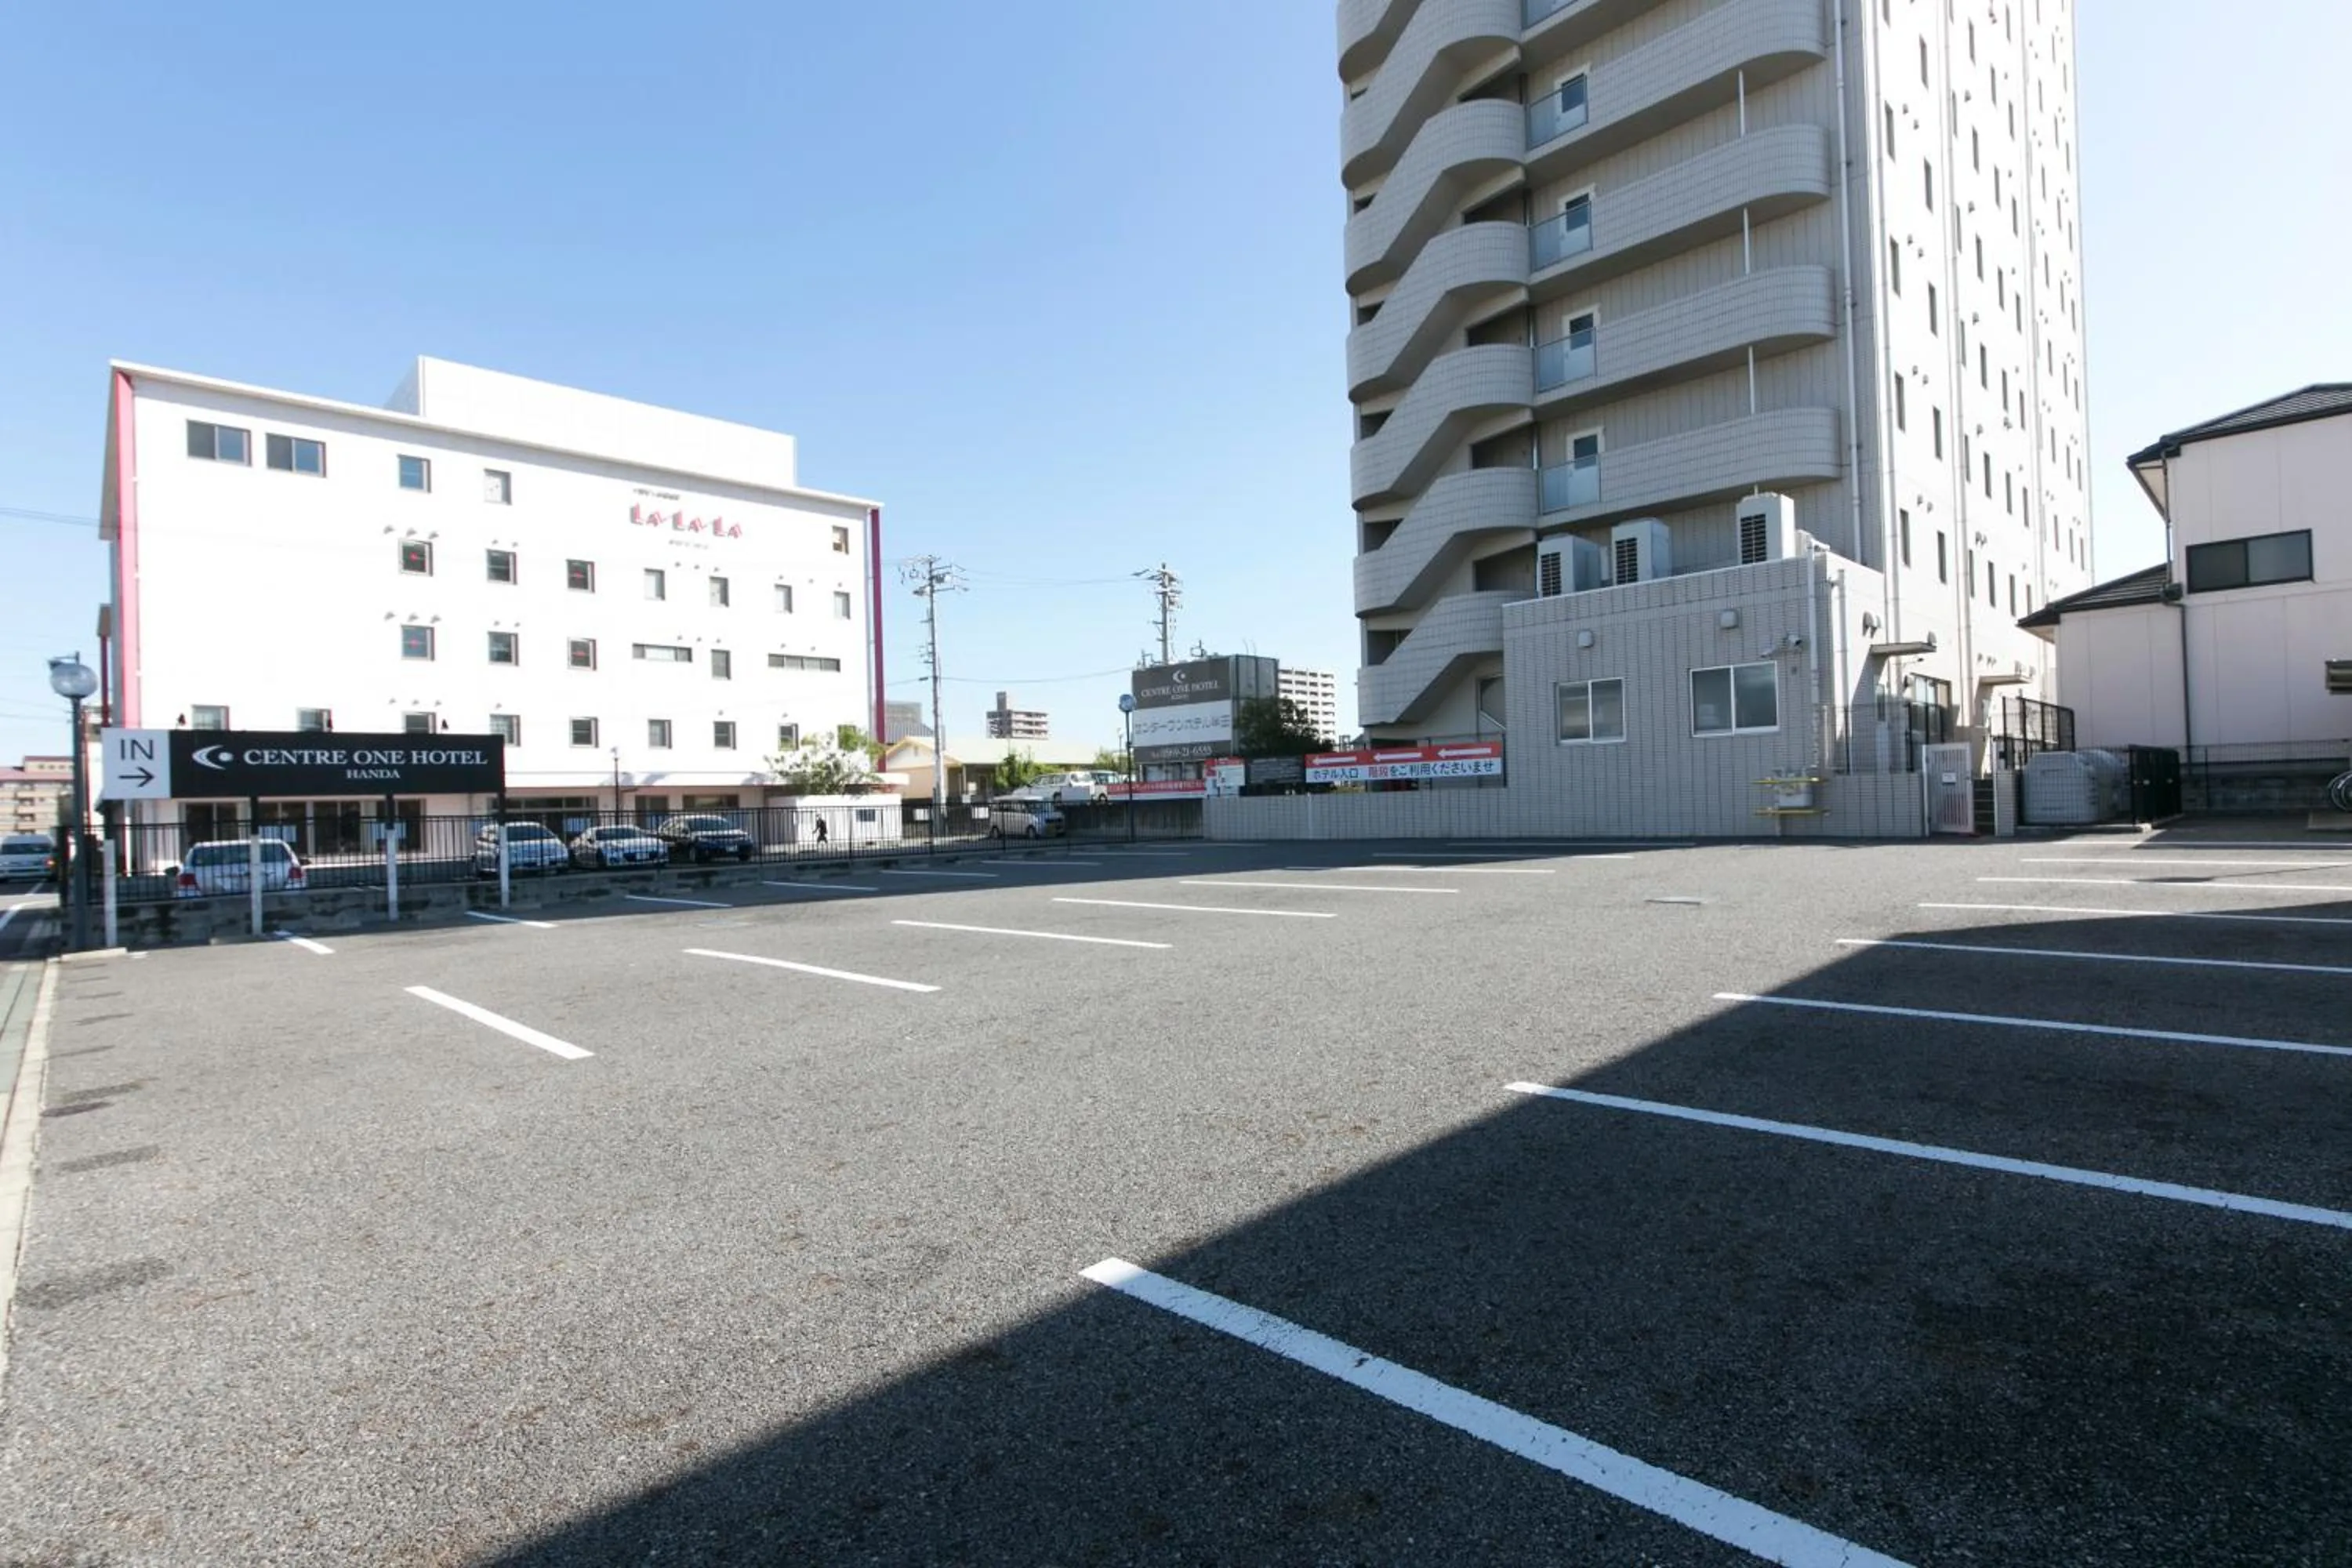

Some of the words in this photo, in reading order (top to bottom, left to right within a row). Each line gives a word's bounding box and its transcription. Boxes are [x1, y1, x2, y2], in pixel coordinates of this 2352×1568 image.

[120, 739, 154, 760] IN
[243, 750, 347, 765] CENTRE
[354, 750, 405, 765] ONE
[411, 750, 488, 765] HOTEL
[347, 768, 401, 779] HANDA
[1313, 768, 1359, 779] ホテル入口
[1368, 760, 1494, 779] 階段をご利用くださいませ
